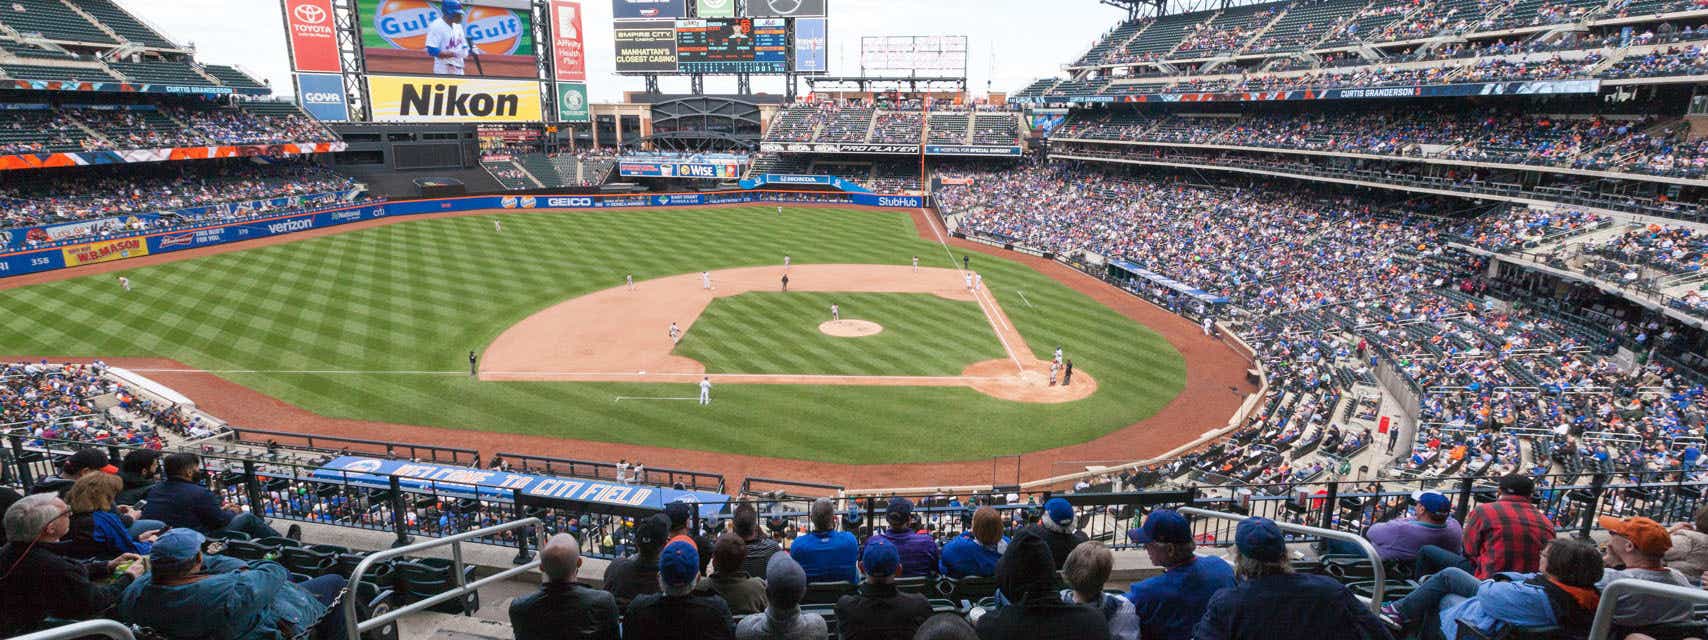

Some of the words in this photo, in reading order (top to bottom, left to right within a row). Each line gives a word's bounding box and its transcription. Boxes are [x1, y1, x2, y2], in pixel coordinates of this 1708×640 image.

[294, 24, 331, 33] TOYOTA
[466, 18, 517, 41] Gulf
[557, 40, 582, 50] Affinity
[621, 48, 670, 56] MANHATTAN'S
[1341, 90, 1364, 98] CURTIS
[1365, 88, 1414, 97] GRANDERSON
[400, 83, 519, 117] Nikon
[868, 145, 917, 153] PLAYER
[691, 165, 713, 176] WISE
[548, 198, 592, 207] GEICO
[879, 197, 917, 207] StubHub
[268, 219, 312, 233] verizon
[31, 257, 49, 266] 358
[392, 464, 494, 483] WELCOME
[500, 475, 533, 489] TO
[530, 479, 584, 498] CITI
[580, 484, 652, 506] FIELD
